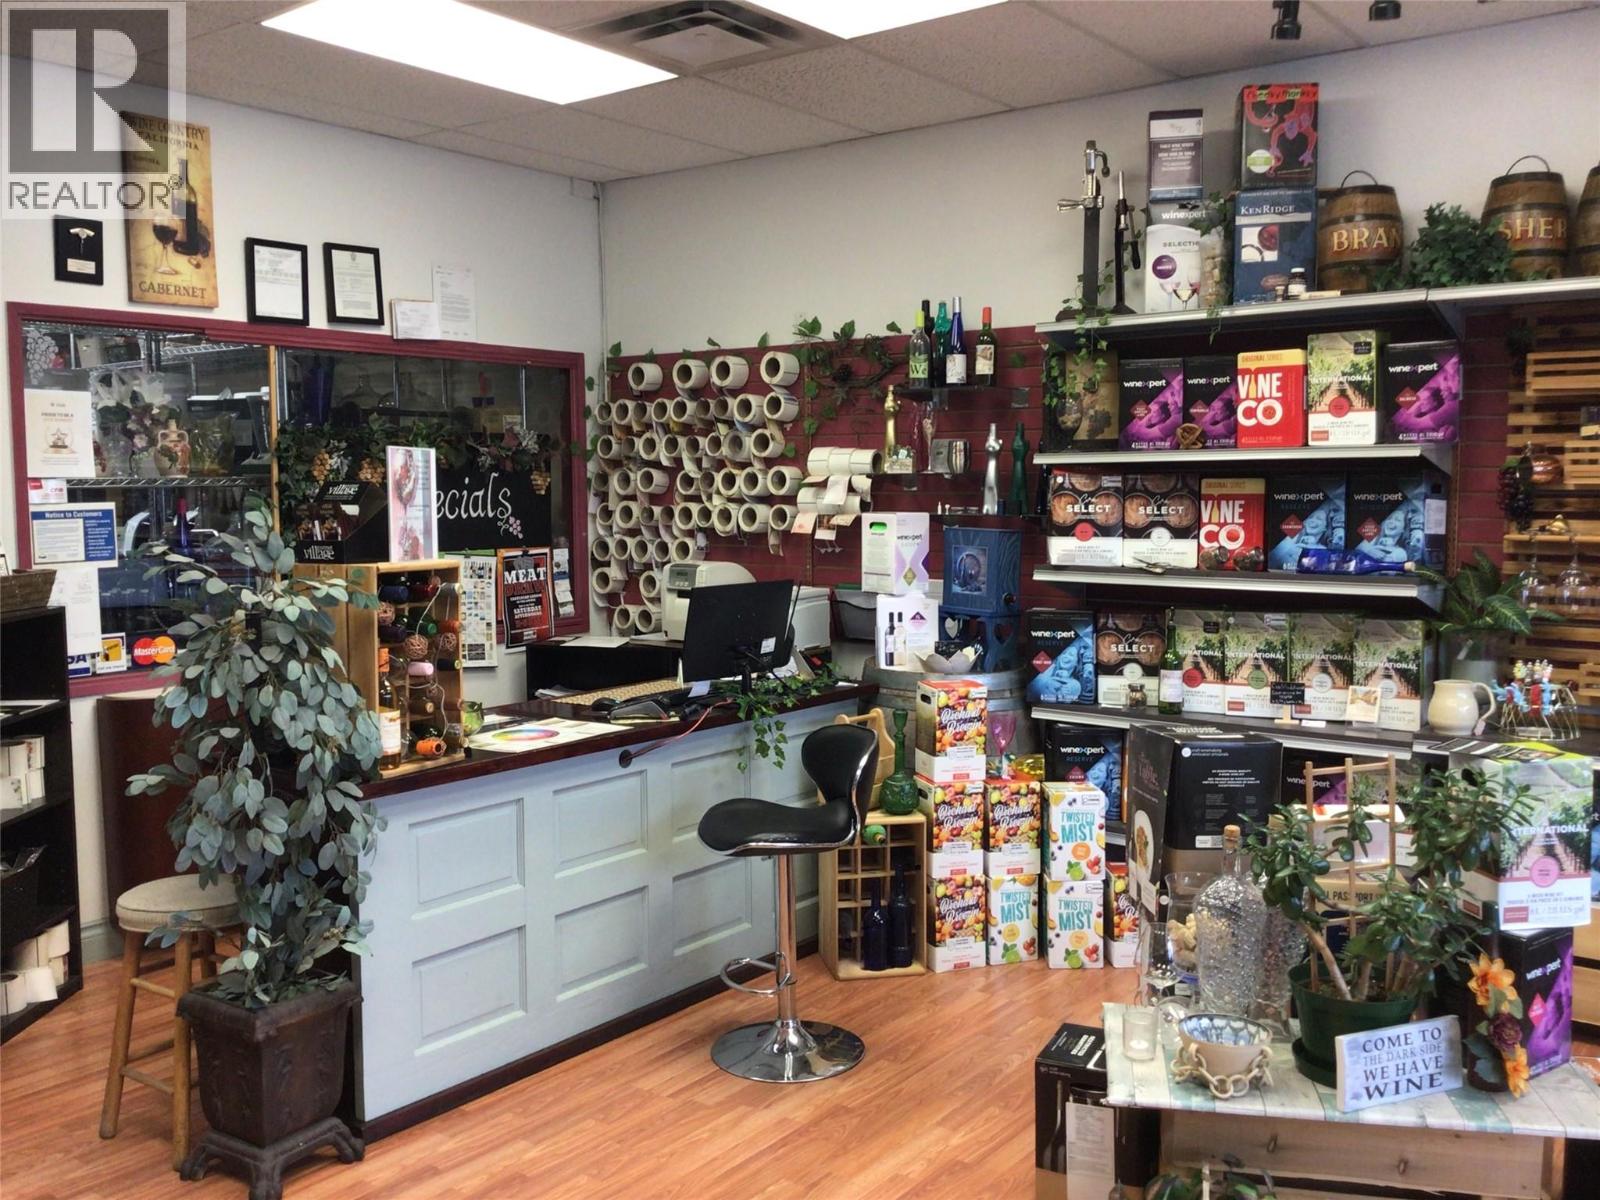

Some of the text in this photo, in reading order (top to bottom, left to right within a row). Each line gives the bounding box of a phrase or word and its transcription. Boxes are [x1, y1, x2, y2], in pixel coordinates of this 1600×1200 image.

[138, 280, 206, 299] CABERNET
[1388, 362, 1439, 374] winexpert
[1123, 379, 1166, 389] winexpert
[1187, 376, 1231, 386] winexpert
[1237, 373, 1283, 399] VINE
[1237, 398, 1283, 427] CO
[436, 473, 513, 519] ecials
[1273, 492, 1324, 502] winexpert
[1353, 492, 1403, 502] winexpert
[1066, 504, 1111, 513] SELECT
[1138, 506, 1185, 514] SELECT
[1200, 500, 1245, 523] VINE
[1199, 524, 1245, 550] CO
[504, 567, 547, 584] MEAT
[513, 605, 542, 614] SATURDAY
[1030, 630, 1075, 640] winexpert
[133, 645, 176, 656] MasterCard
[1110, 644, 1156, 653] SELECT
[1226, 651, 1286, 660] INTERNATIONAL
[1354, 661, 1418, 670] INTERNATIONAL
[1060, 746, 1105, 755] winexpert
[1286, 776, 1330, 788] winepert
[1061, 811, 1095, 825] TWISTED
[1061, 822, 1094, 843] MIST
[1001, 891, 1032, 905] TWISTED
[1000, 902, 1030, 924] MIST
[1058, 899, 1093, 914] TWISTED
[1058, 910, 1092, 931] MIST
[1362, 1027, 1442, 1053] COME TO
[1363, 1041, 1442, 1067] THE DARK SIDE
[1363, 1056, 1444, 1082] WE HAVE
[1364, 1071, 1443, 1101] WINE
